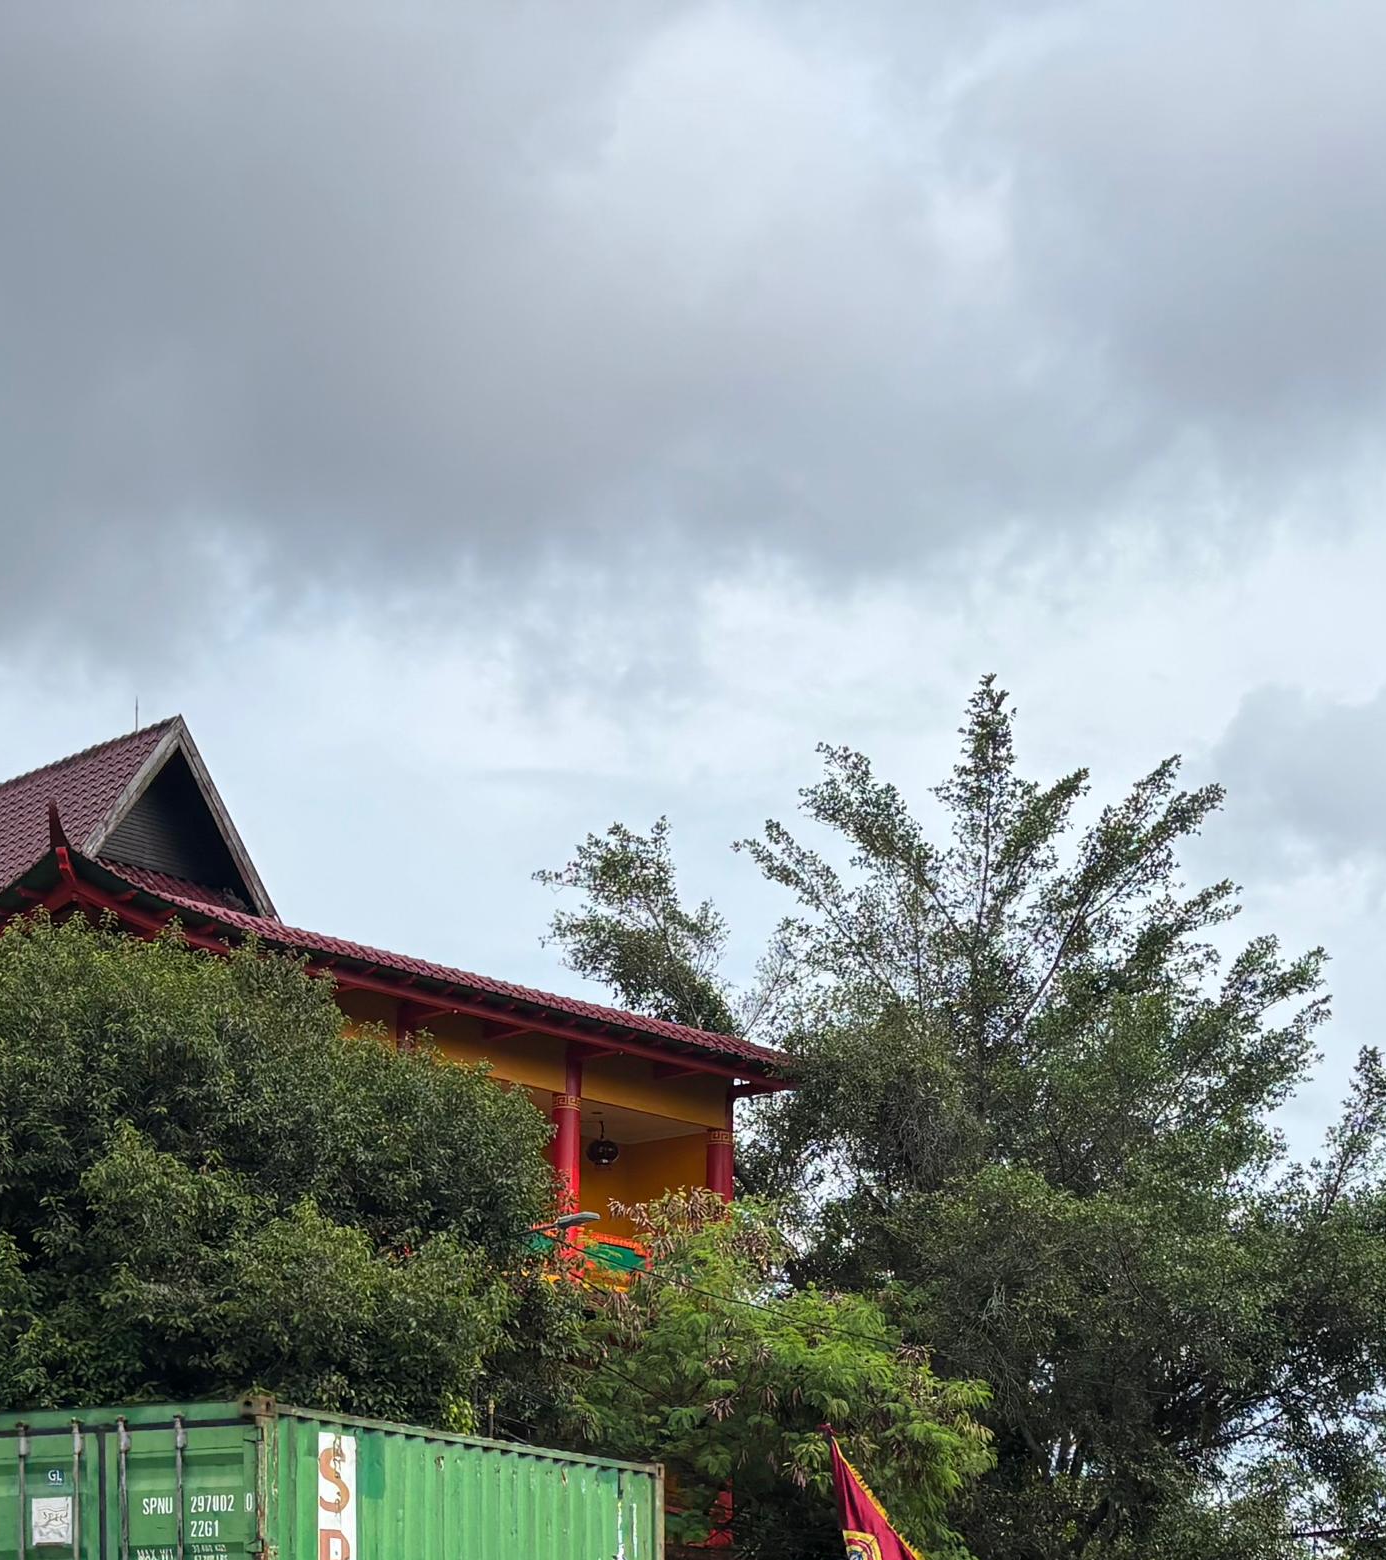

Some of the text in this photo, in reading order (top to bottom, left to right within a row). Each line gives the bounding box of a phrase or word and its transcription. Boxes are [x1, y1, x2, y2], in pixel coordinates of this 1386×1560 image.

[142, 1493, 254, 1515] SPNU 297002 0
[190, 1520, 219, 1537] 22G1
